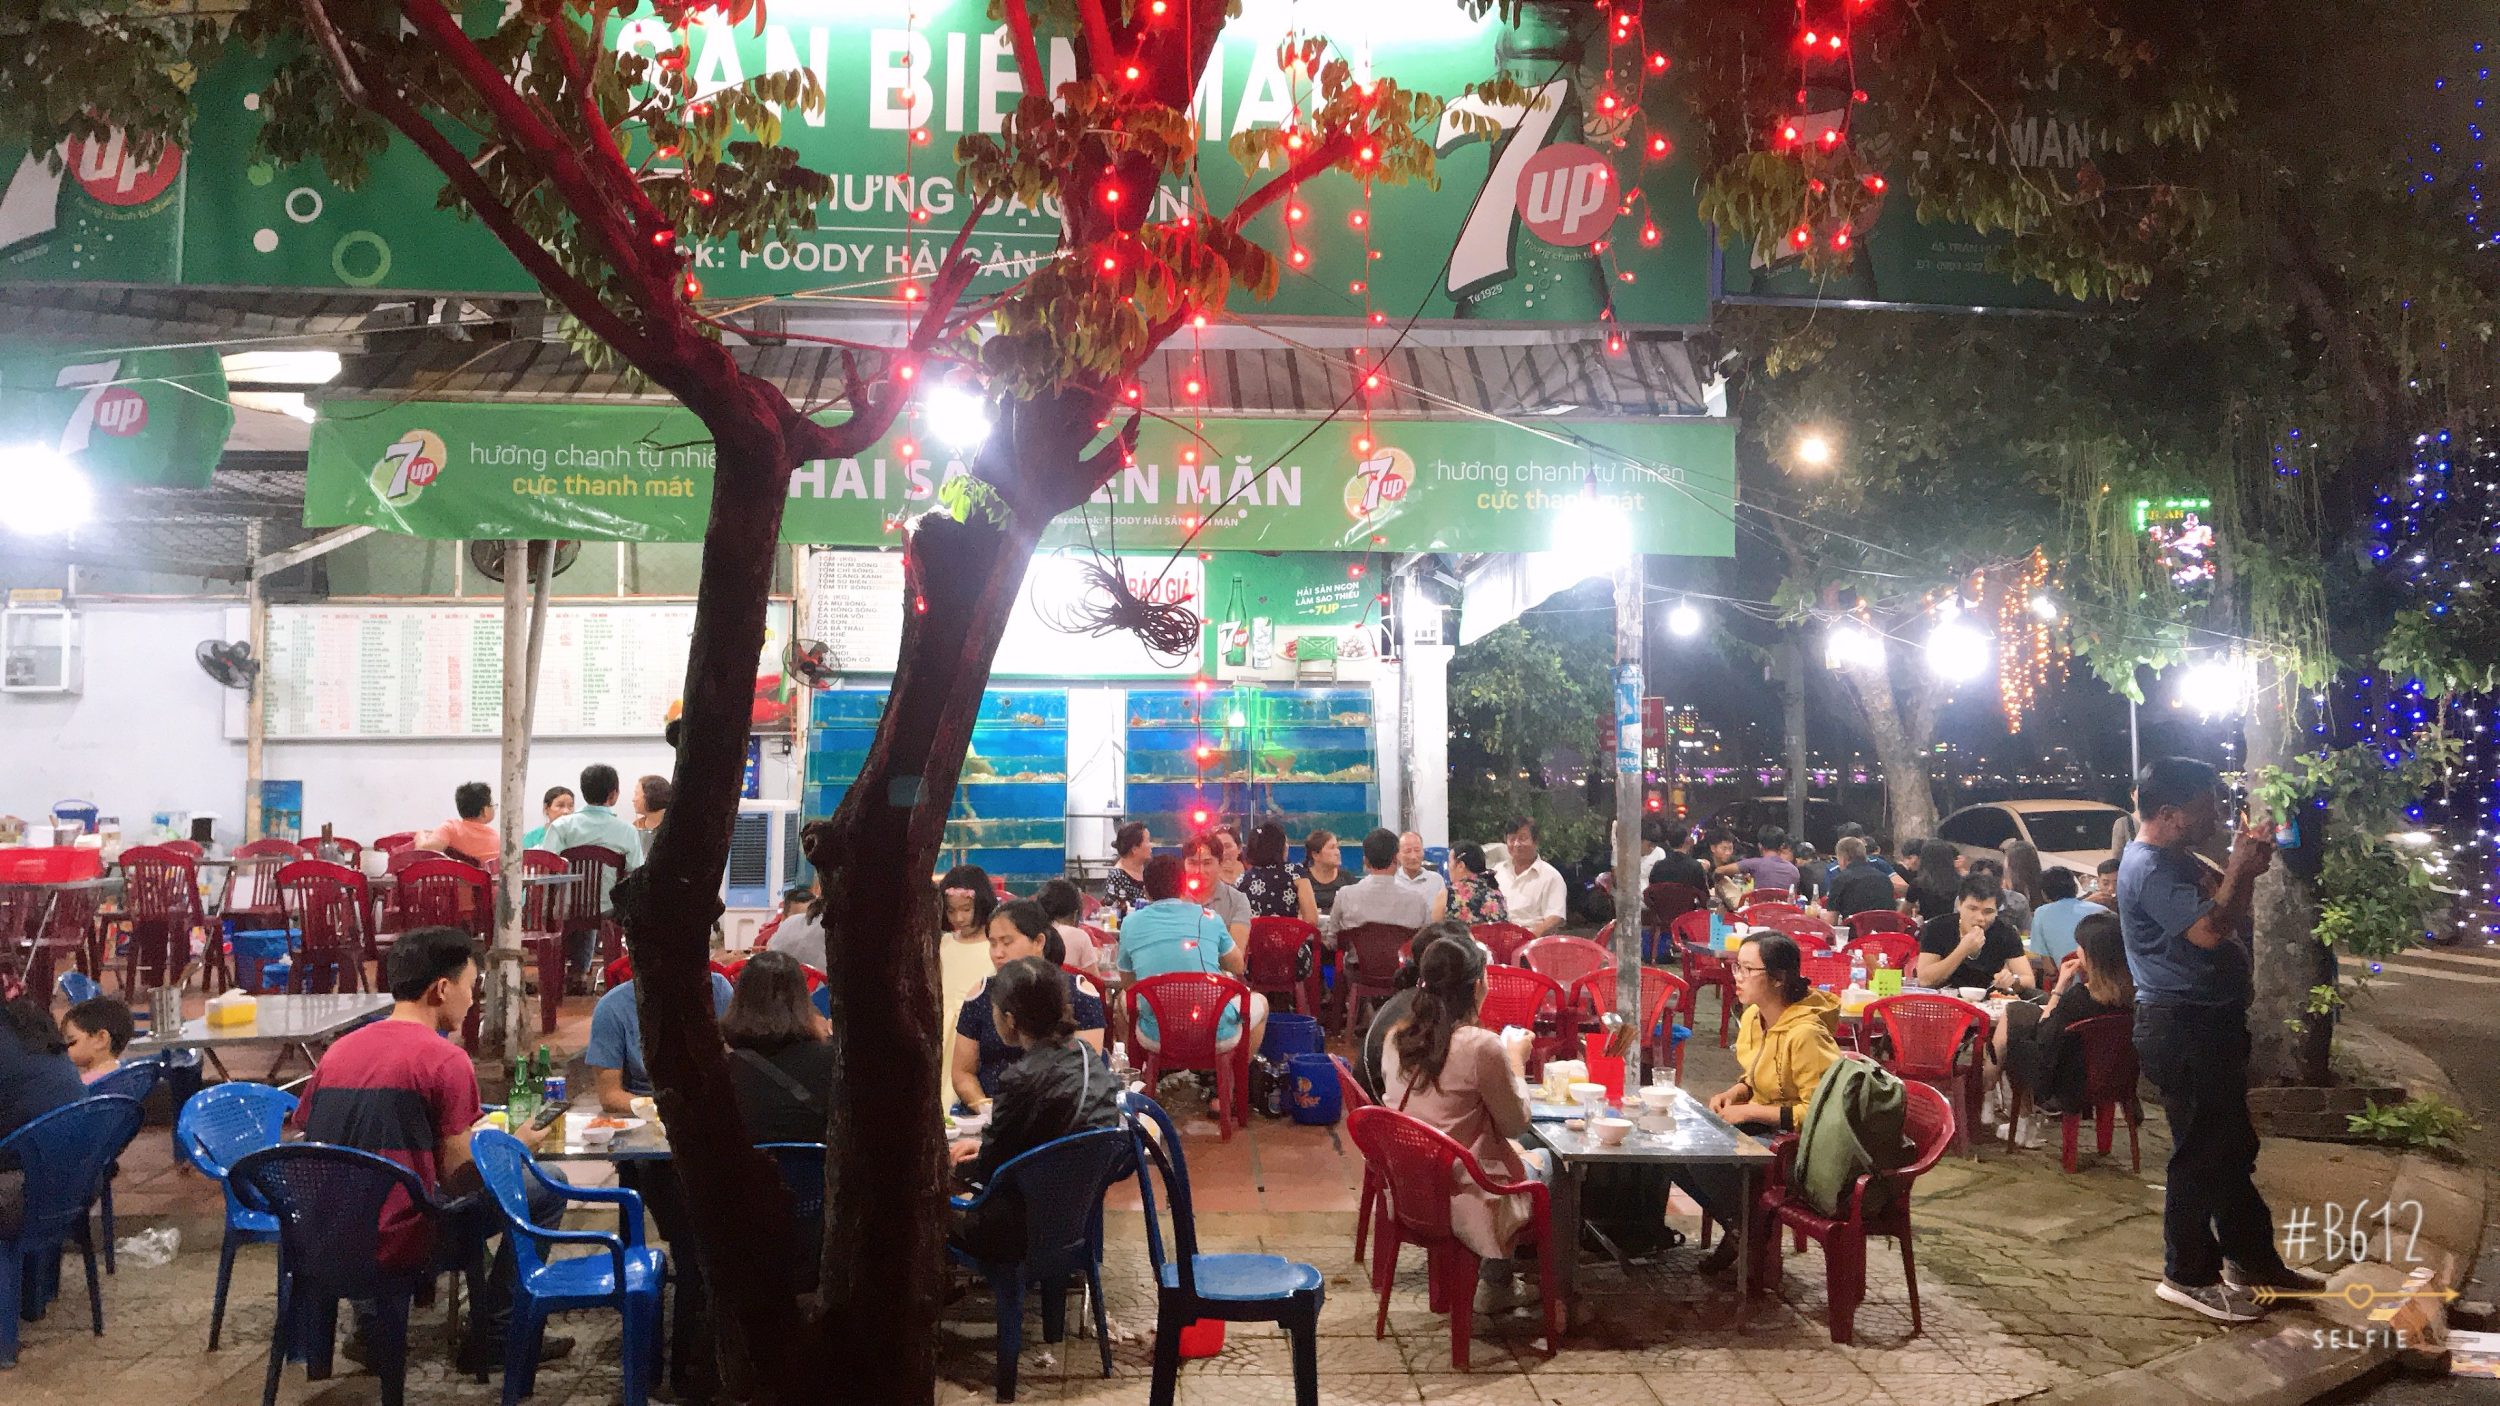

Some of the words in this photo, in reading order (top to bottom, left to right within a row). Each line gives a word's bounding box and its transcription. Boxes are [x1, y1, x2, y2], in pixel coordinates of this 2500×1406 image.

[555, 444, 630, 466] chanh
[671, 446, 716, 468] nhiê
[1515, 461, 1586, 482] chanh
[512, 475, 557, 496] cực
[565, 473, 637, 496] thanh
[645, 475, 695, 497] mát
[1176, 455, 1302, 519] MẶN
[1105, 515, 1141, 526] FOODY
[1315, 602, 1339, 615] 7UP
